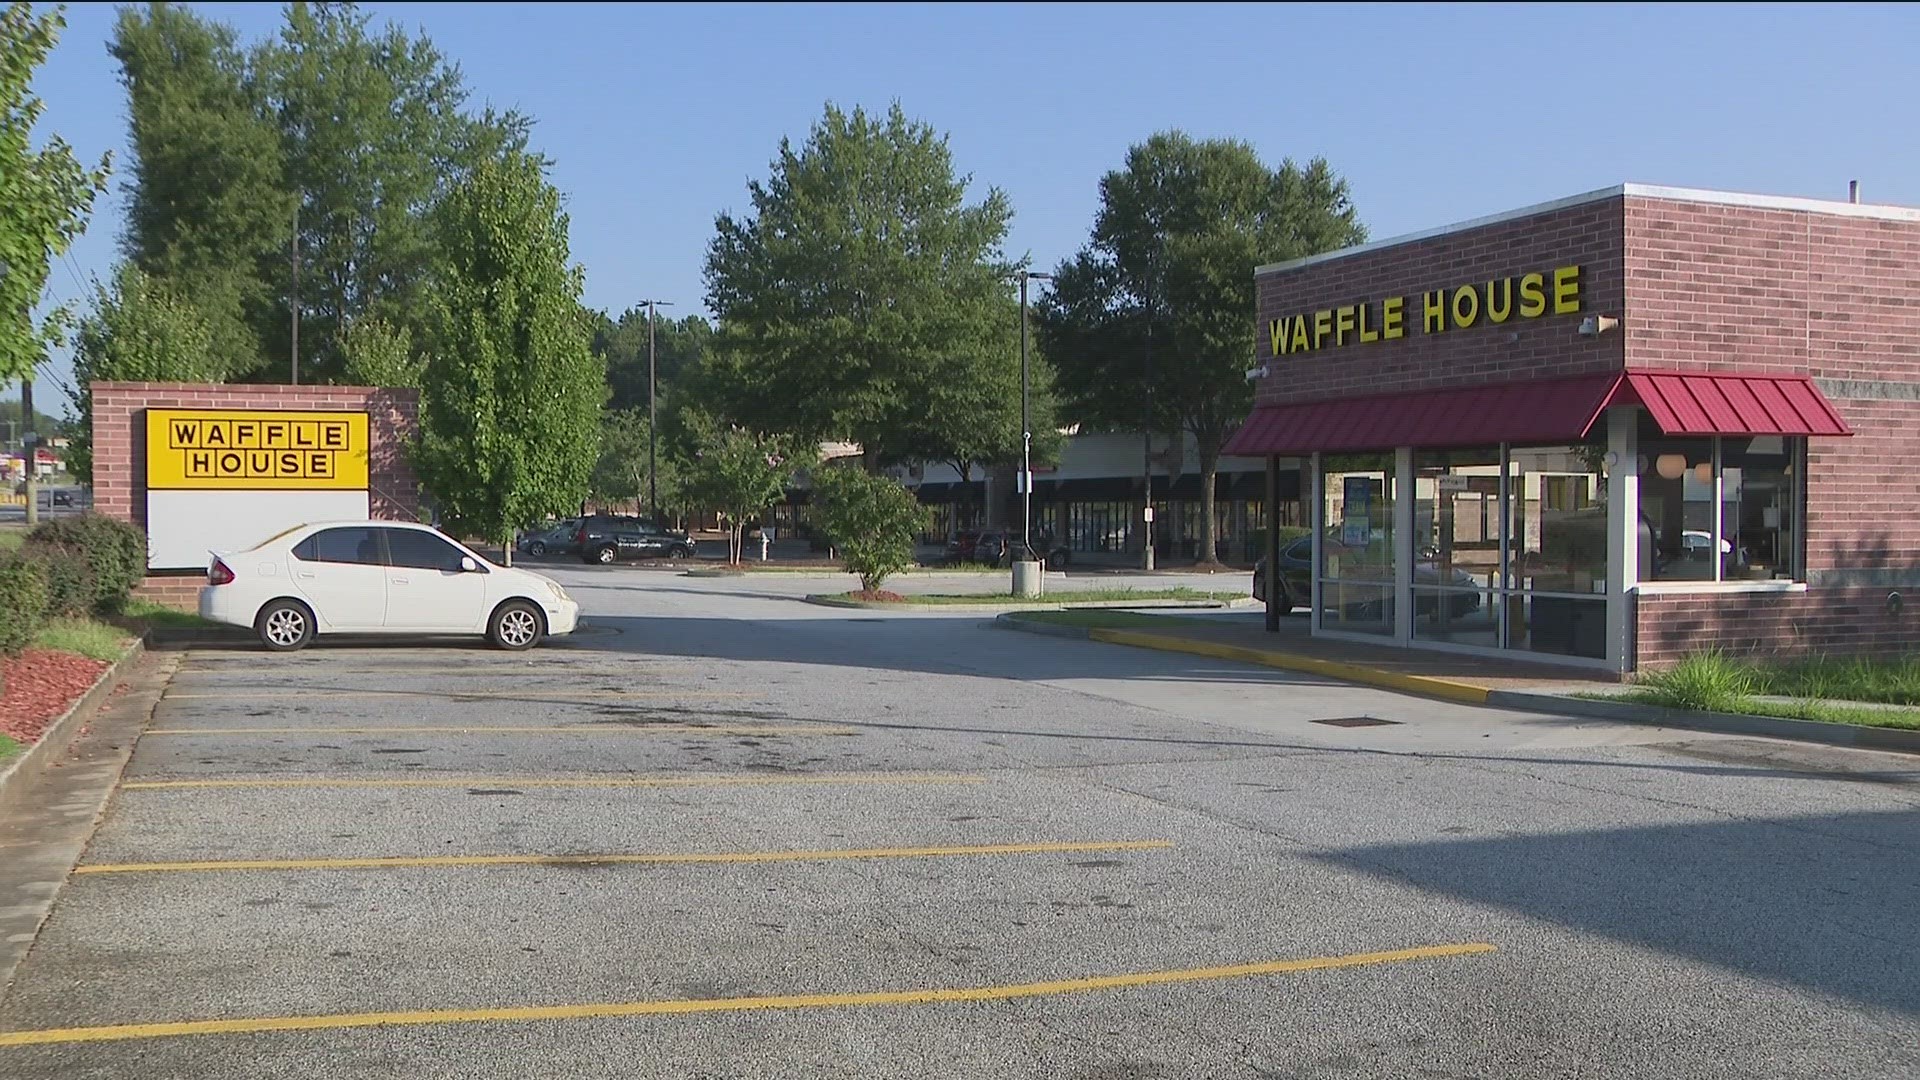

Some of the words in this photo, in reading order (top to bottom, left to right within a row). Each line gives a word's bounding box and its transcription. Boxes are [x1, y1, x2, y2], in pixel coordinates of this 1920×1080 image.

[1269, 296, 1404, 356] WAFFLE
[1423, 265, 1580, 334] HOUSE
[175, 424, 342, 446] WAFFLE
[192, 453, 328, 473] HOUSE
